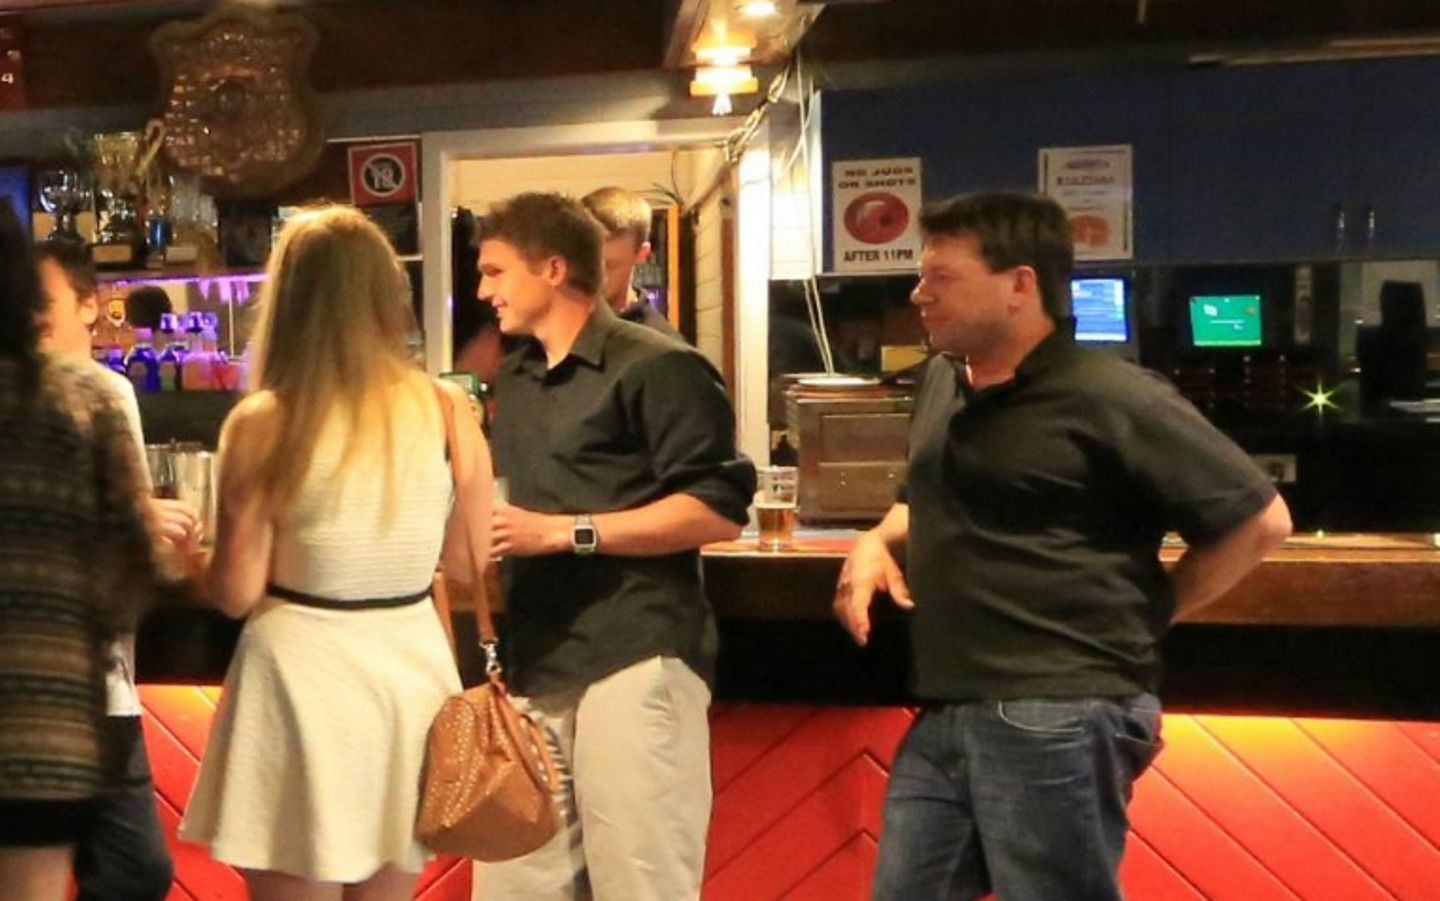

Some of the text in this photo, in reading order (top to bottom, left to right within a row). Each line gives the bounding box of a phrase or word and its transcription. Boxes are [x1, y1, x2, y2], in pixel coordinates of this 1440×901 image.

[1, 73, 13, 84] 4
[844, 169, 868, 177] NO
[838, 178, 916, 189] OR SHOTS
[844, 249, 880, 262] AFTER
